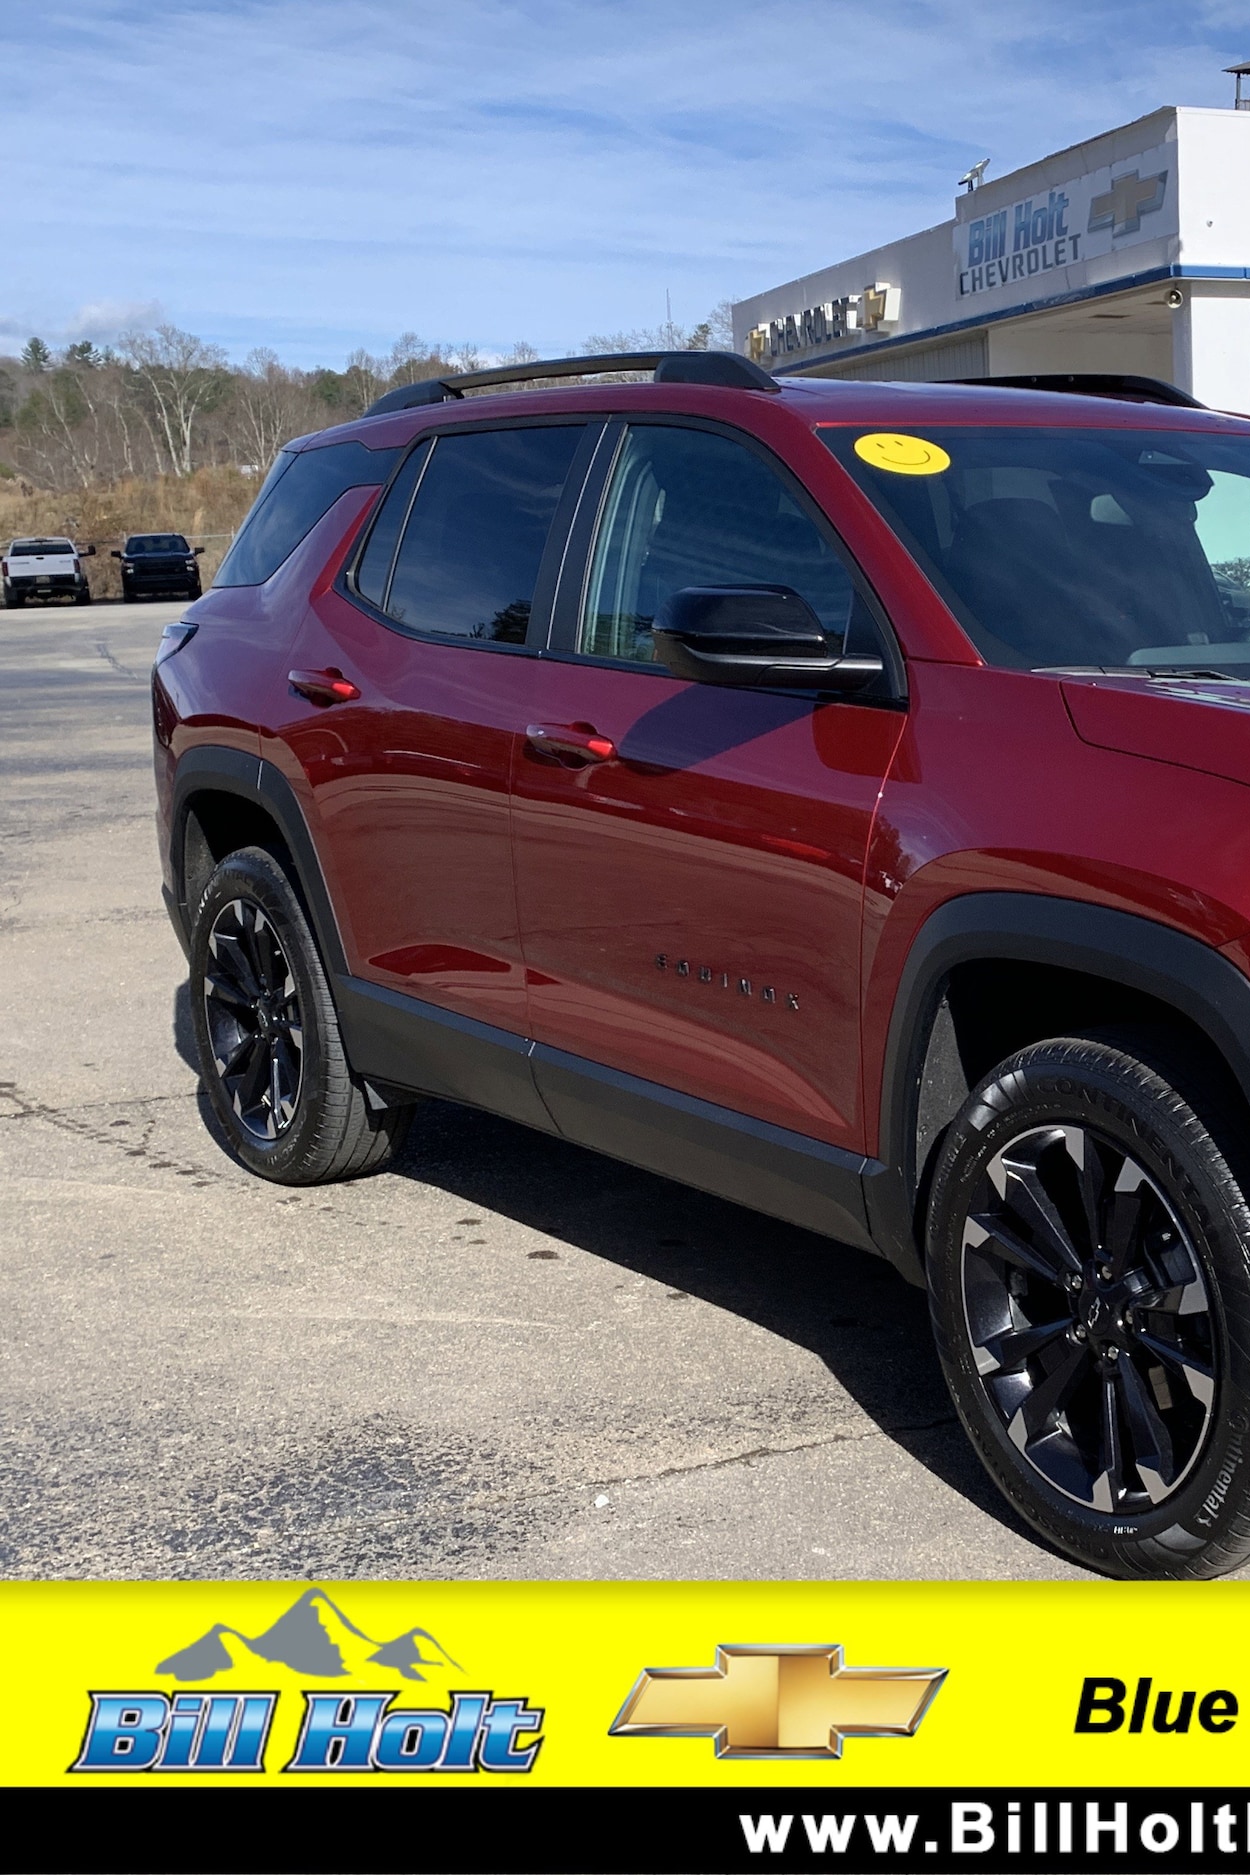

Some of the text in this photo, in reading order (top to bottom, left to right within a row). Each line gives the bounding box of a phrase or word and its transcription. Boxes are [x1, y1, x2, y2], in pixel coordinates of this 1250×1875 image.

[968, 192, 1069, 268] Bill Holt
[960, 233, 1081, 296] CHEVROLET
[769, 296, 864, 357] CHEVROLET
